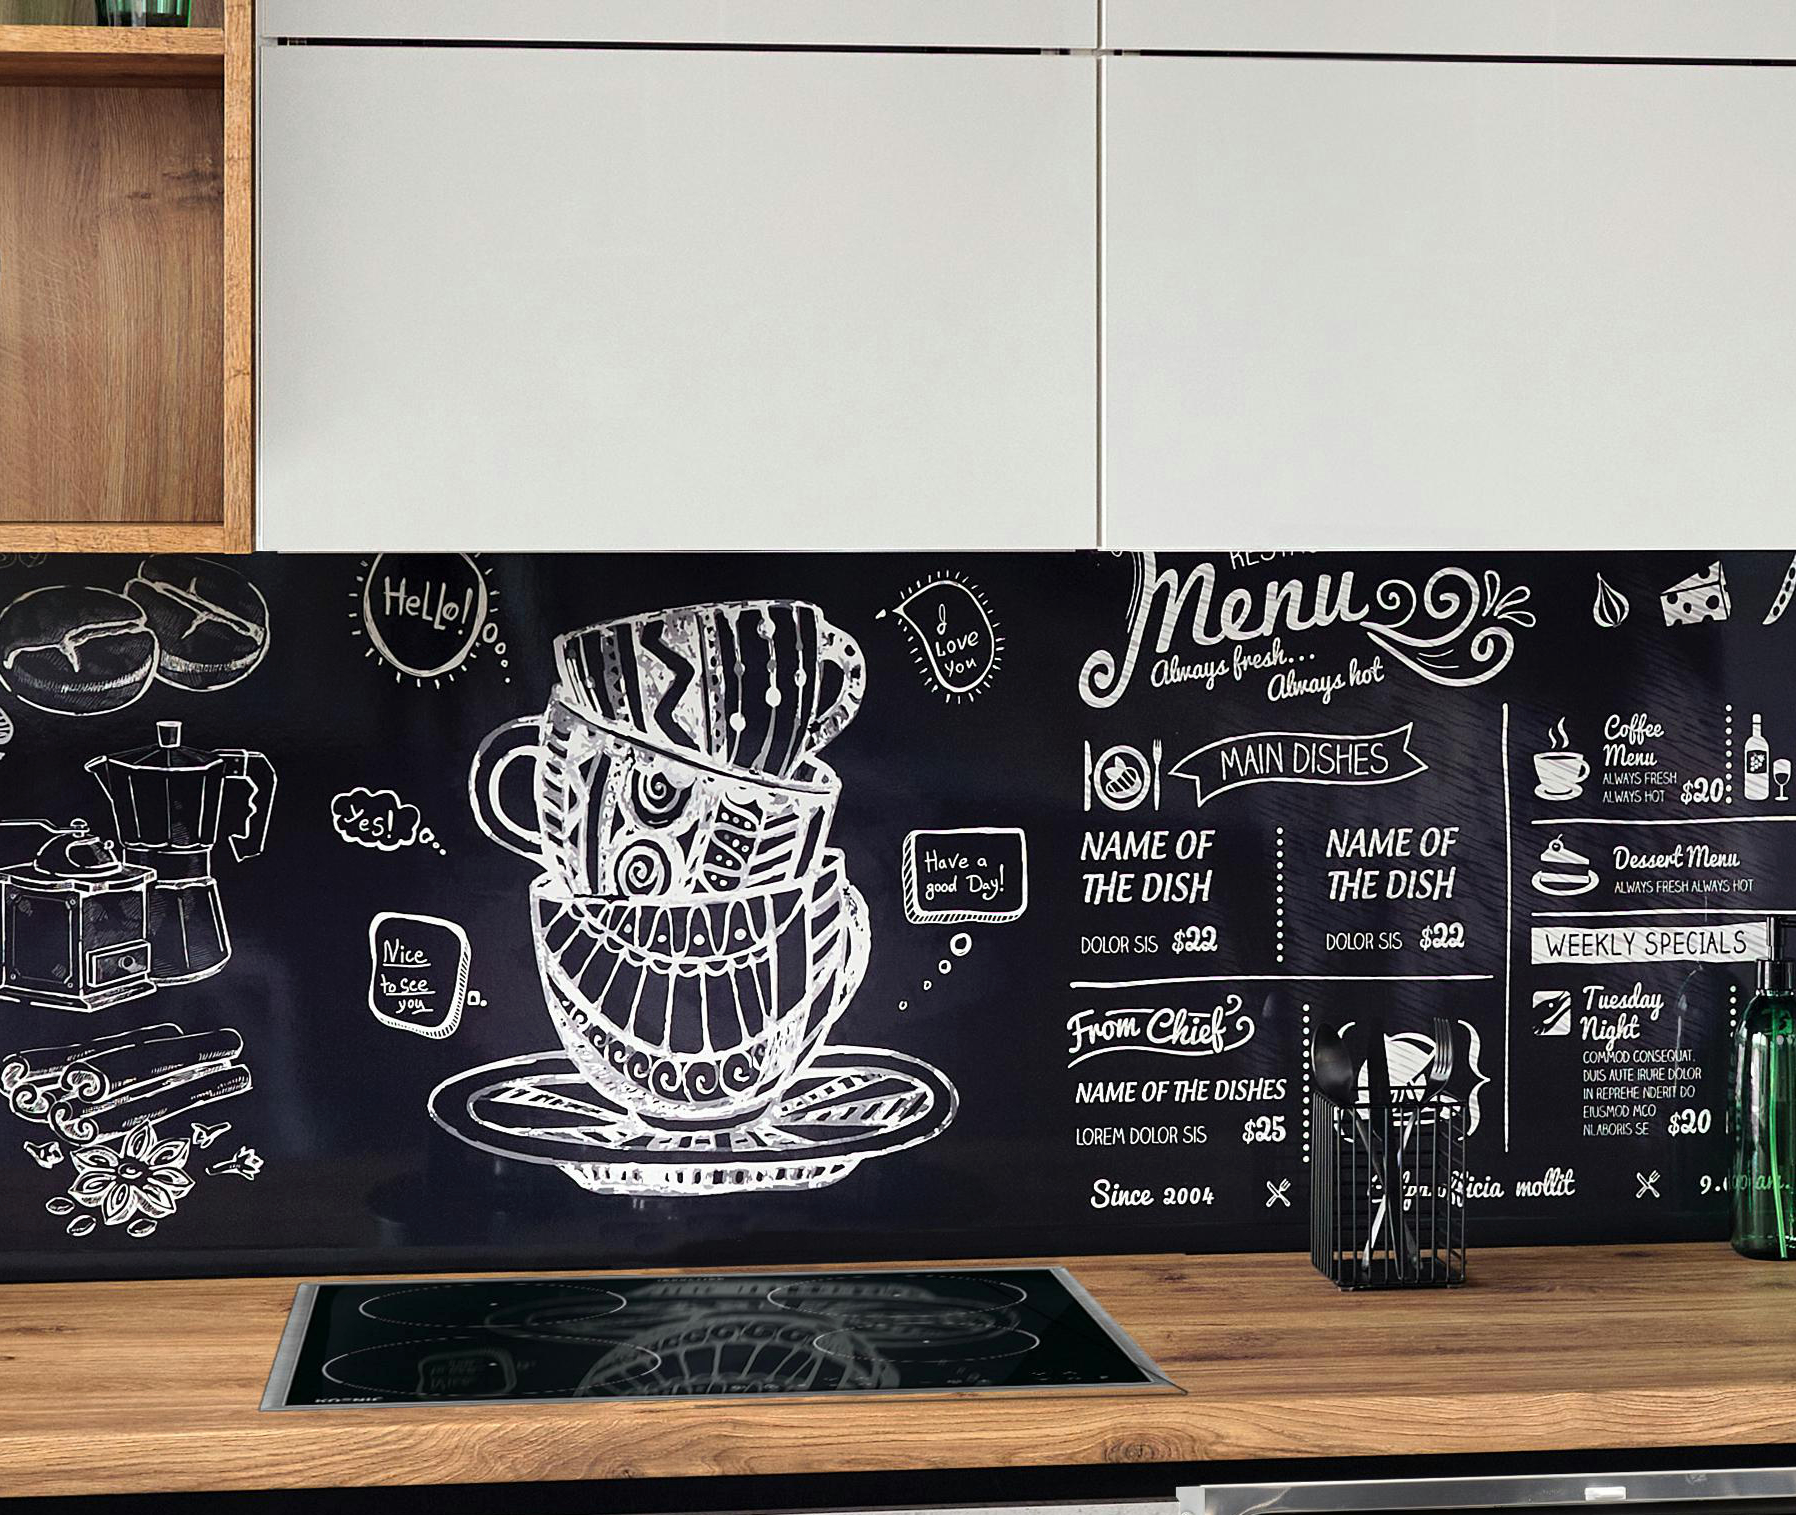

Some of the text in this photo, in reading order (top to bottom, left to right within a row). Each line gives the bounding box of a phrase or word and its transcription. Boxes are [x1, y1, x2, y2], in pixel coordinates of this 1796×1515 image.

[1078, 551, 1370, 708] Menu
[1151, 657, 1229, 690] Always
[1267, 656, 1385, 704] Always hot
[1604, 713, 1664, 745] Coffee
[1221, 743, 1389, 780] MAIN DISHES
[1603, 744, 1657, 768] Menu
[1603, 771, 1677, 786] ALWAYS FRESH
[1603, 777, 1724, 804] ALWAYS HOT $20
[1080, 829, 1216, 860] NAME OF
[1326, 826, 1459, 857] NAME OF
[924, 850, 989, 874] Have a
[1613, 844, 1741, 871] Dessert Menu
[924, 863, 1005, 901] good Day!
[1082, 869, 1213, 904] THE DISH
[1327, 867, 1456, 900] THE DISH
[1614, 881, 1654, 894] ALWAYS
[1656, 880, 1689, 893] FRESH
[1691, 880, 1731, 893] ALWAYS
[1733, 879, 1754, 892] HOT
[1081, 926, 1218, 954] DOLOR SIS $22
[1326, 922, 1465, 951] DOLOR SIS $22
[1546, 931, 1747, 958] WEEKLY SPECIALS
[382, 939, 427, 965] Nice
[380, 974, 430, 996] to see
[396, 994, 427, 1014] you
[1582, 982, 1664, 1021] Tuesday
[1066, 1000, 1247, 1054] From Chief
[1580, 1013, 1641, 1051] Night
[1583, 1049, 1696, 1064] COMMOD CONSEQUAT.
[1583, 1066, 1702, 1082] DUIS AUTE IRURE DOLOR
[1075, 1078, 1287, 1104] NAME OF THE DISHES
[1583, 1085, 1695, 1100] IN REPREHE NDERIT DO
[1583, 1104, 1656, 1118] EIUSMOD MCO
[1583, 1108, 1711, 1137] NLABORIS SE $20
[1075, 1116, 1286, 1146] LOREM DOLOR SIS $25
[1091, 1178, 1215, 1210] Since 2004
[1516, 1166, 1576, 1197] mollit
